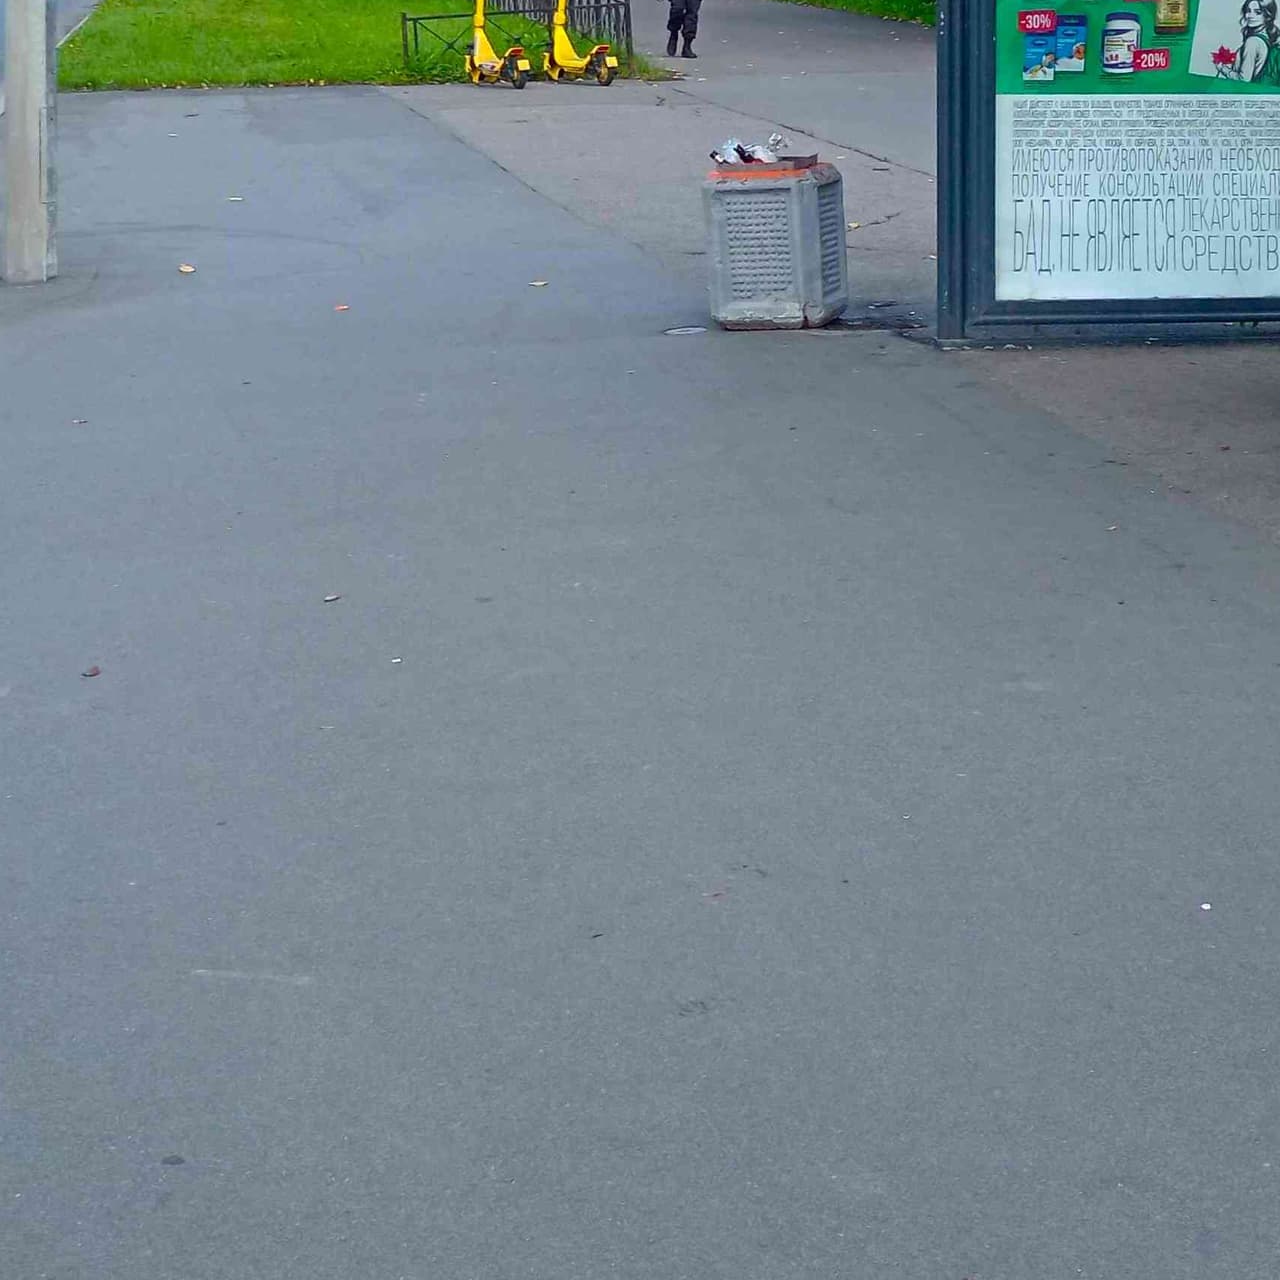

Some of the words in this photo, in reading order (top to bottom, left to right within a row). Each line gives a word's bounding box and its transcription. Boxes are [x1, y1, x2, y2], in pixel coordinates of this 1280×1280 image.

[1020, 14, 1051, 29] -30%
[1136, 52, 1167, 68] -20%
[1012, 148, 1074, 172] ИМЕЮТСЯ
[1078, 148, 1213, 172] ПРОТИВОПОКАЗАНИЯ
[1012, 173, 1091, 197] ПОЛУЧЕНИЕ
[1099, 172, 1204, 197] КОНСУЛЬТАЦИИ
[1060, 199, 1081, 272] НЕ
[1086, 198, 1176, 272] ЯВЛЯЕТСЯ
